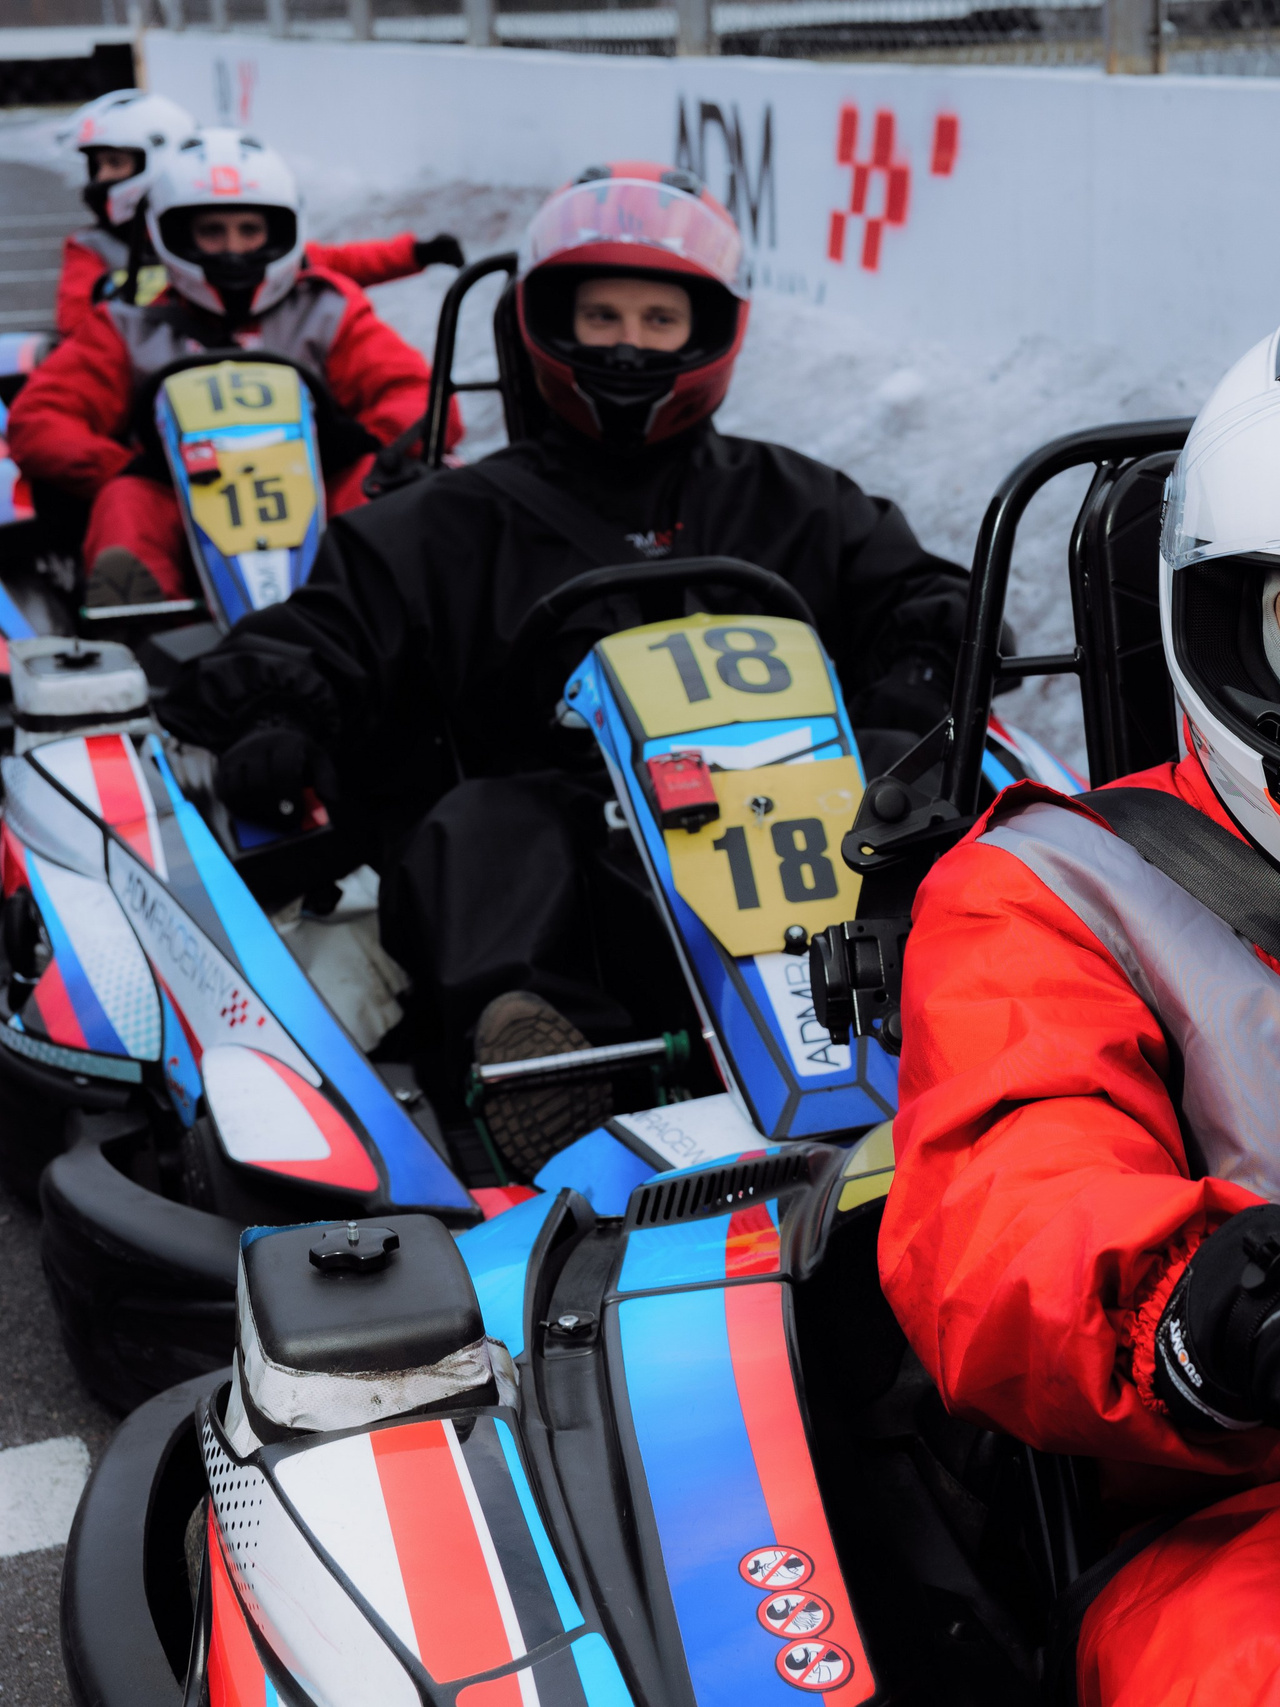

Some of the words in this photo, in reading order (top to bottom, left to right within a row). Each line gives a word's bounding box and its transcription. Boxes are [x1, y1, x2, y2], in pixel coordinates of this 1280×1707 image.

[196, 373, 274, 412] 15
[219, 477, 288, 527] 15
[648, 626, 793, 705] 18
[712, 817, 839, 911] 18
[785, 959, 841, 1067] ADMR
[630, 1109, 713, 1165] RACEW
[1169, 1318, 1204, 1388] SUOMY
